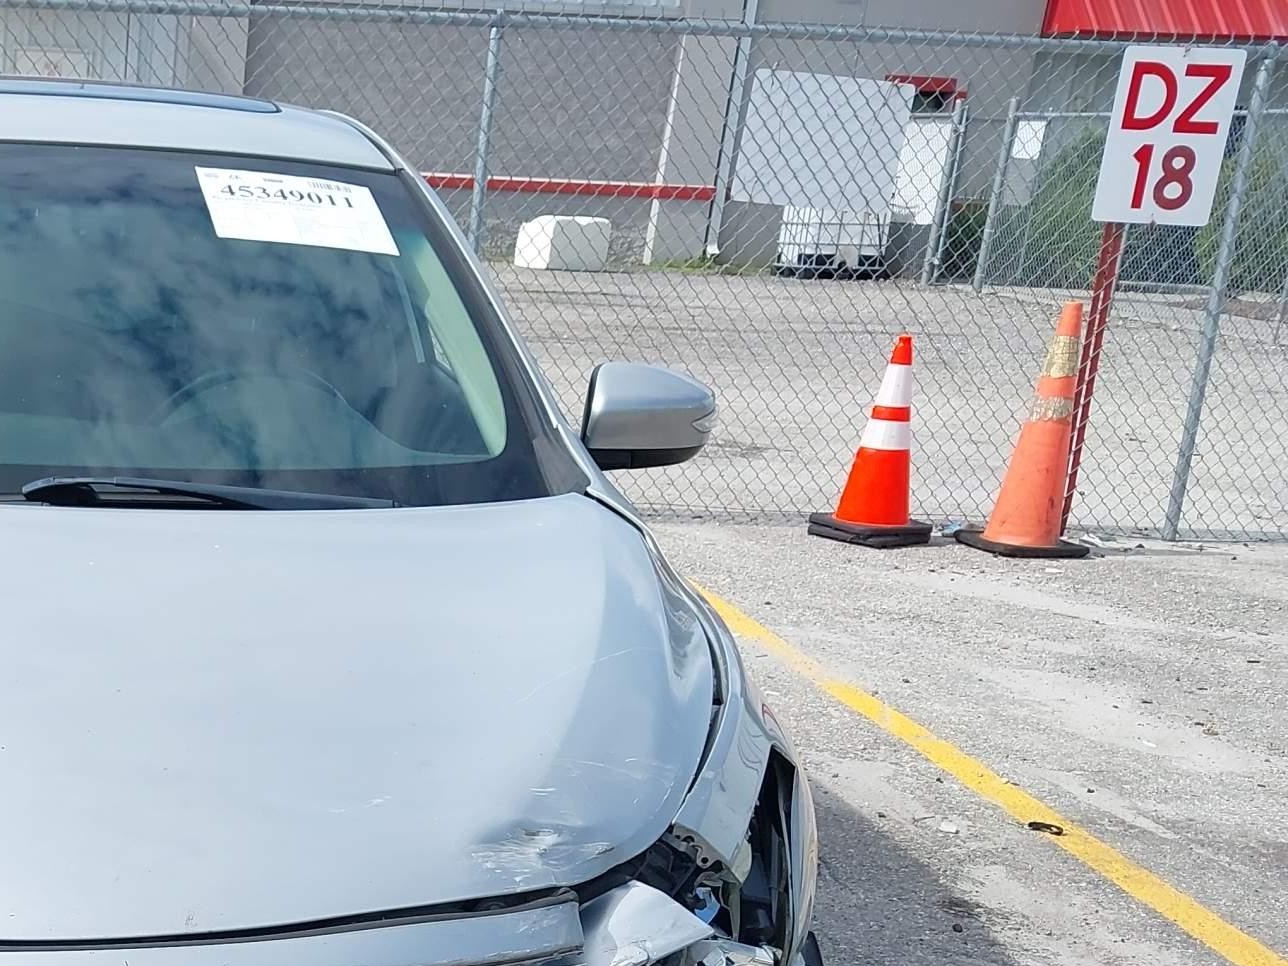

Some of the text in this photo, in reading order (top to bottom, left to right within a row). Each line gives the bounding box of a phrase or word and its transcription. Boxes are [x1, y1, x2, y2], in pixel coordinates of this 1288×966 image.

[1121, 61, 1233, 135] DZ
[220, 184, 355, 209] 45349011
[1130, 143, 1197, 211] 18
